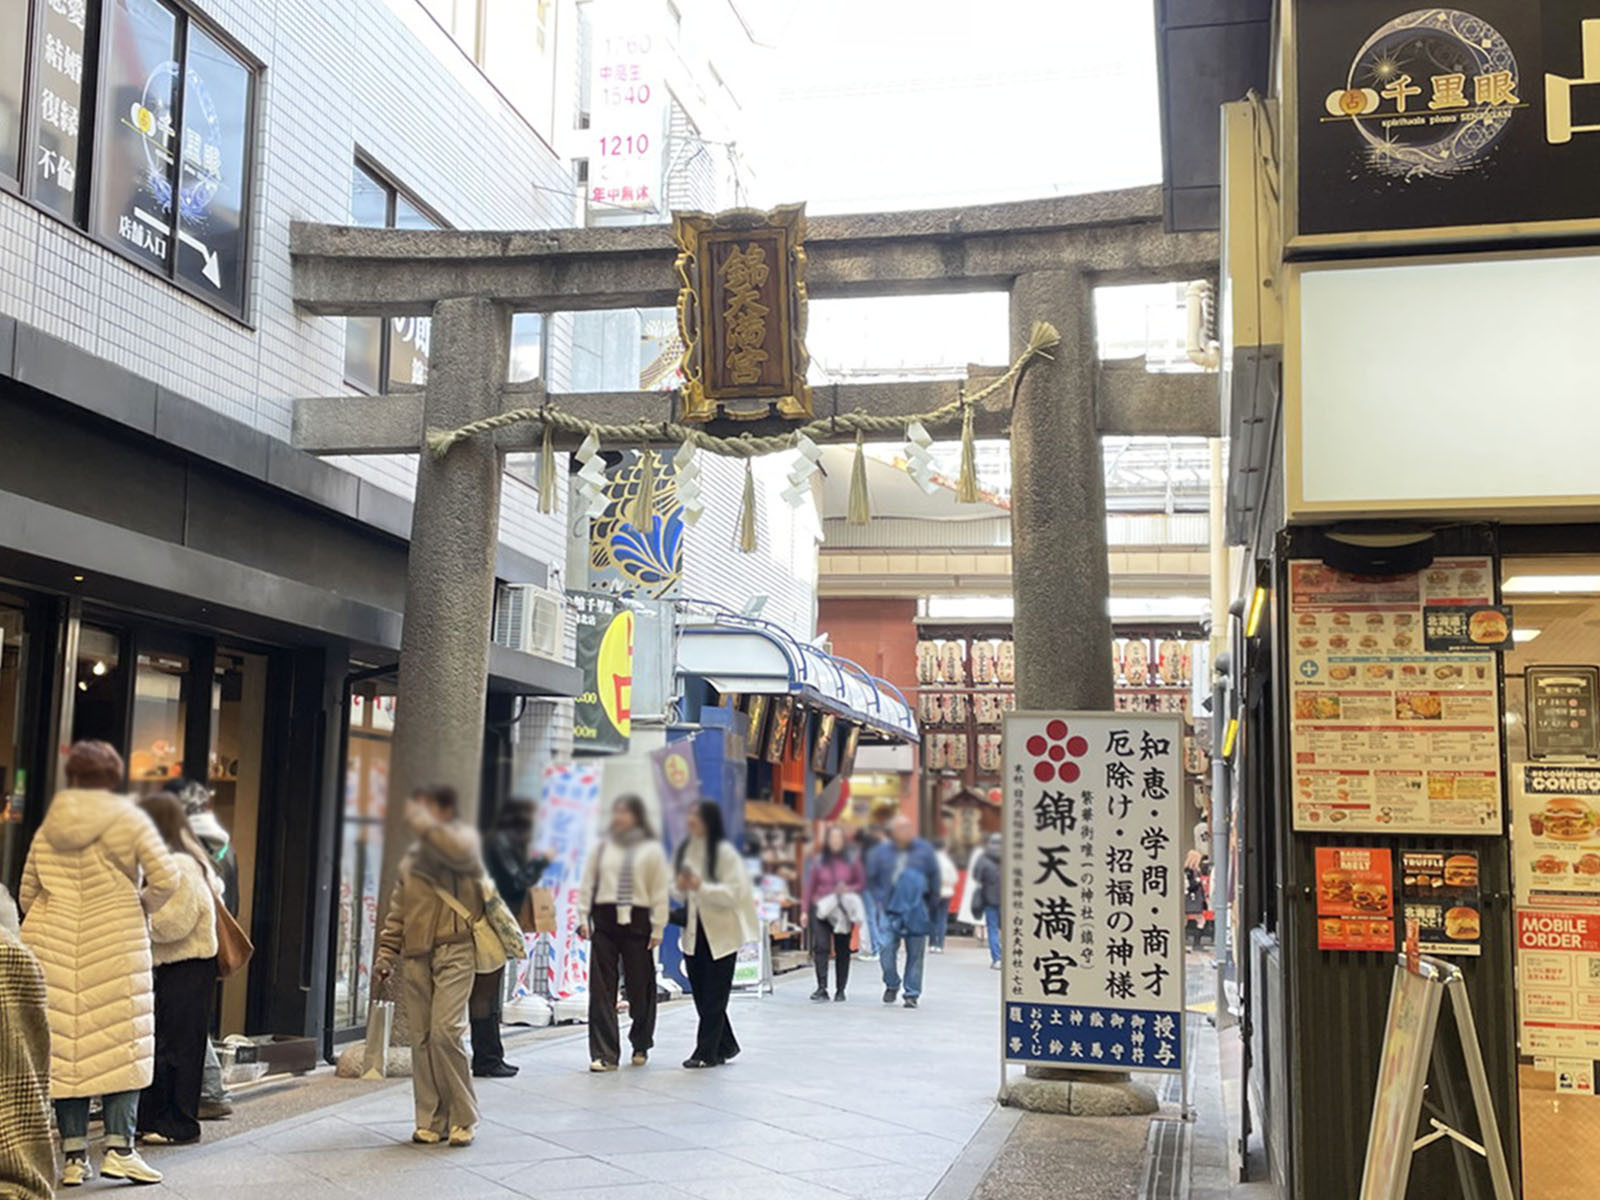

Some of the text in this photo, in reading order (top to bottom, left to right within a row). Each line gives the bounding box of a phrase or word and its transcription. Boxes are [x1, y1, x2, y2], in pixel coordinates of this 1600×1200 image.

[603, 84, 650, 104] 1540
[1382, 70, 1520, 113] 千里眼
[600, 133, 649, 156] 1210
[592, 185, 650, 201] 年中無休
[118, 215, 168, 259] 店舗入口
[1105, 729, 1136, 999] 厄除け・招福の神様
[1140, 730, 1170, 997] 知恵・学問・商才
[1033, 790, 1078, 997] 錦天満宮
[1522, 917, 1588, 934] MOBILE
[1522, 931, 1582, 949] ORDER
[1030, 1007, 1043, 1055] おみくじ
[1153, 1014, 1176, 1066] 授与
